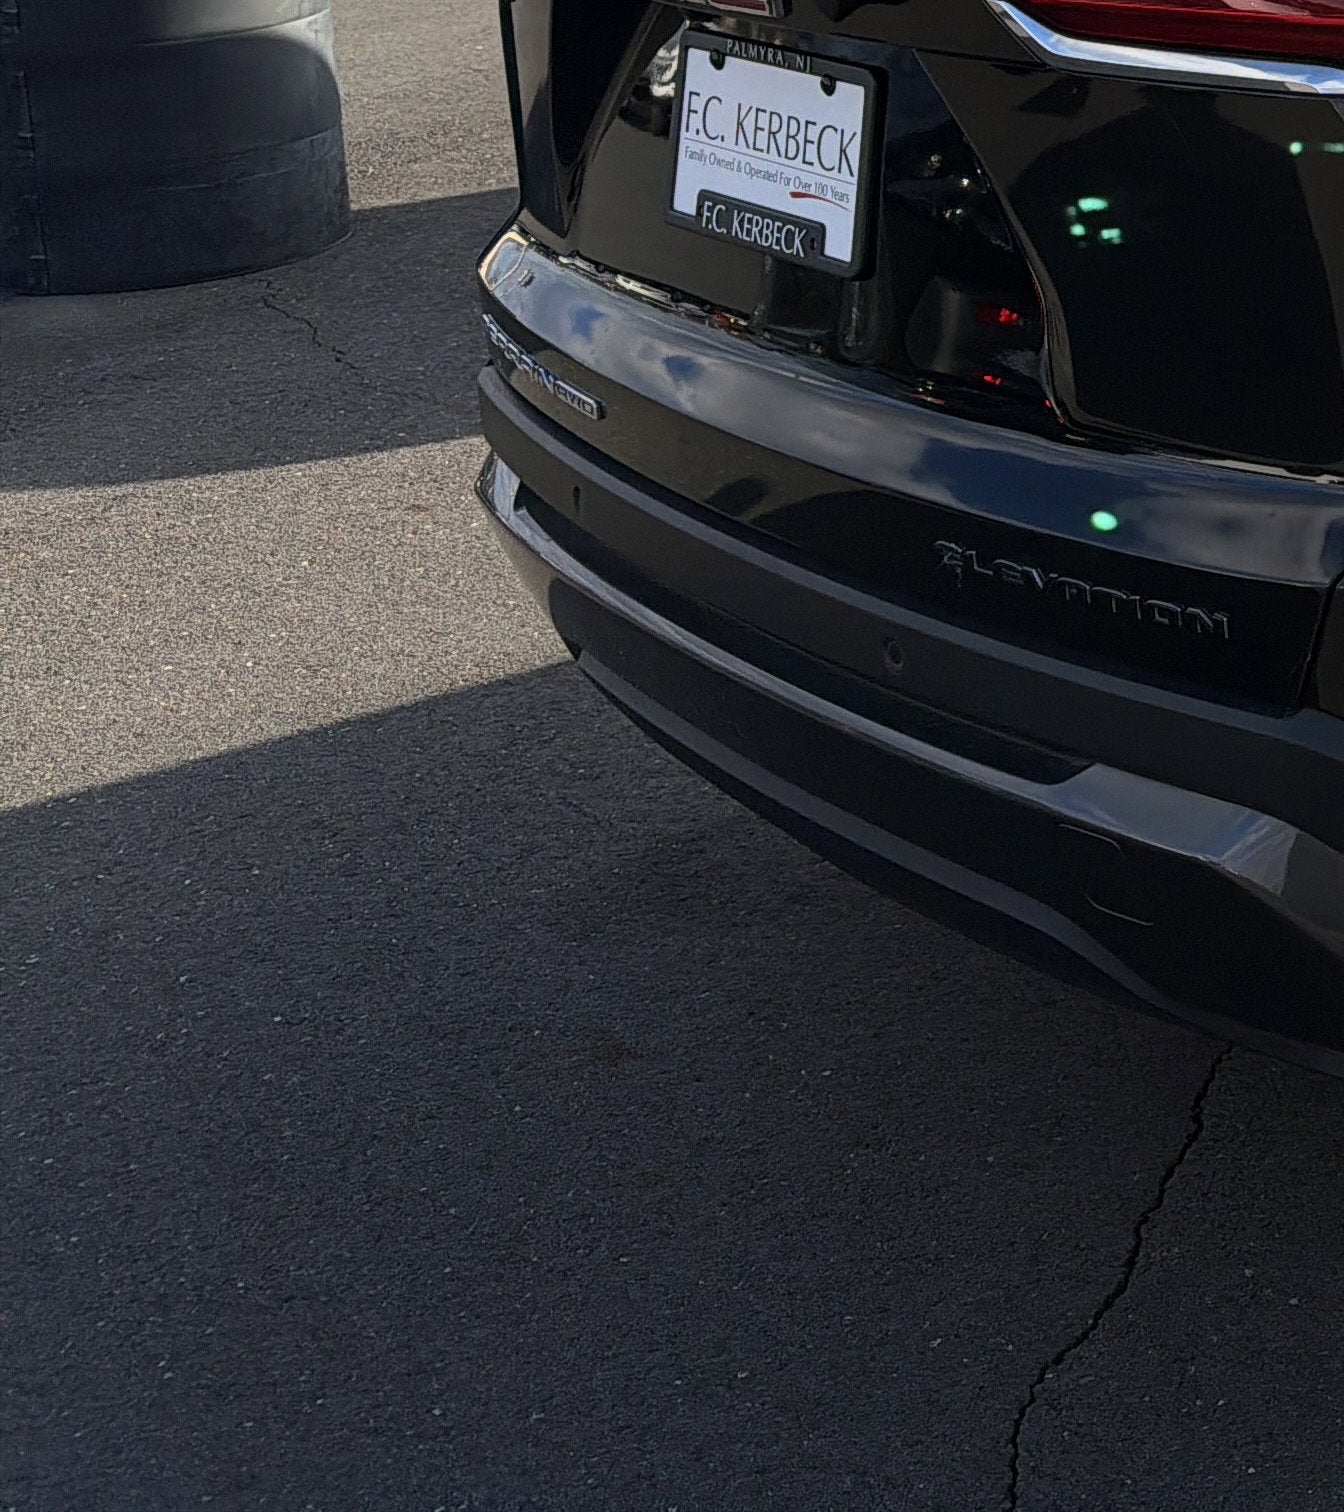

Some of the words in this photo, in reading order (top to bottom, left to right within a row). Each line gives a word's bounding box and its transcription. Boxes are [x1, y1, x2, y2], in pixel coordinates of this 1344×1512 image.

[726, 40, 789, 68] PALMYRA,
[795, 55, 812, 74] NJ
[685, 90, 726, 143] F.C.
[735, 102, 857, 178] KERBECK
[684, 145, 707, 166] Family
[708, 152, 735, 171] Owned
[736, 158, 743, 174] &
[743, 162, 778, 185] Operated
[779, 167, 792, 187] For
[793, 174, 812, 193] Over
[813, 182, 829, 197] 100
[830, 185, 850, 204] Years
[701, 201, 727, 234] F.C.
[731, 208, 807, 258] KERBECK
[933, 539, 1229, 639] ELEVATION
